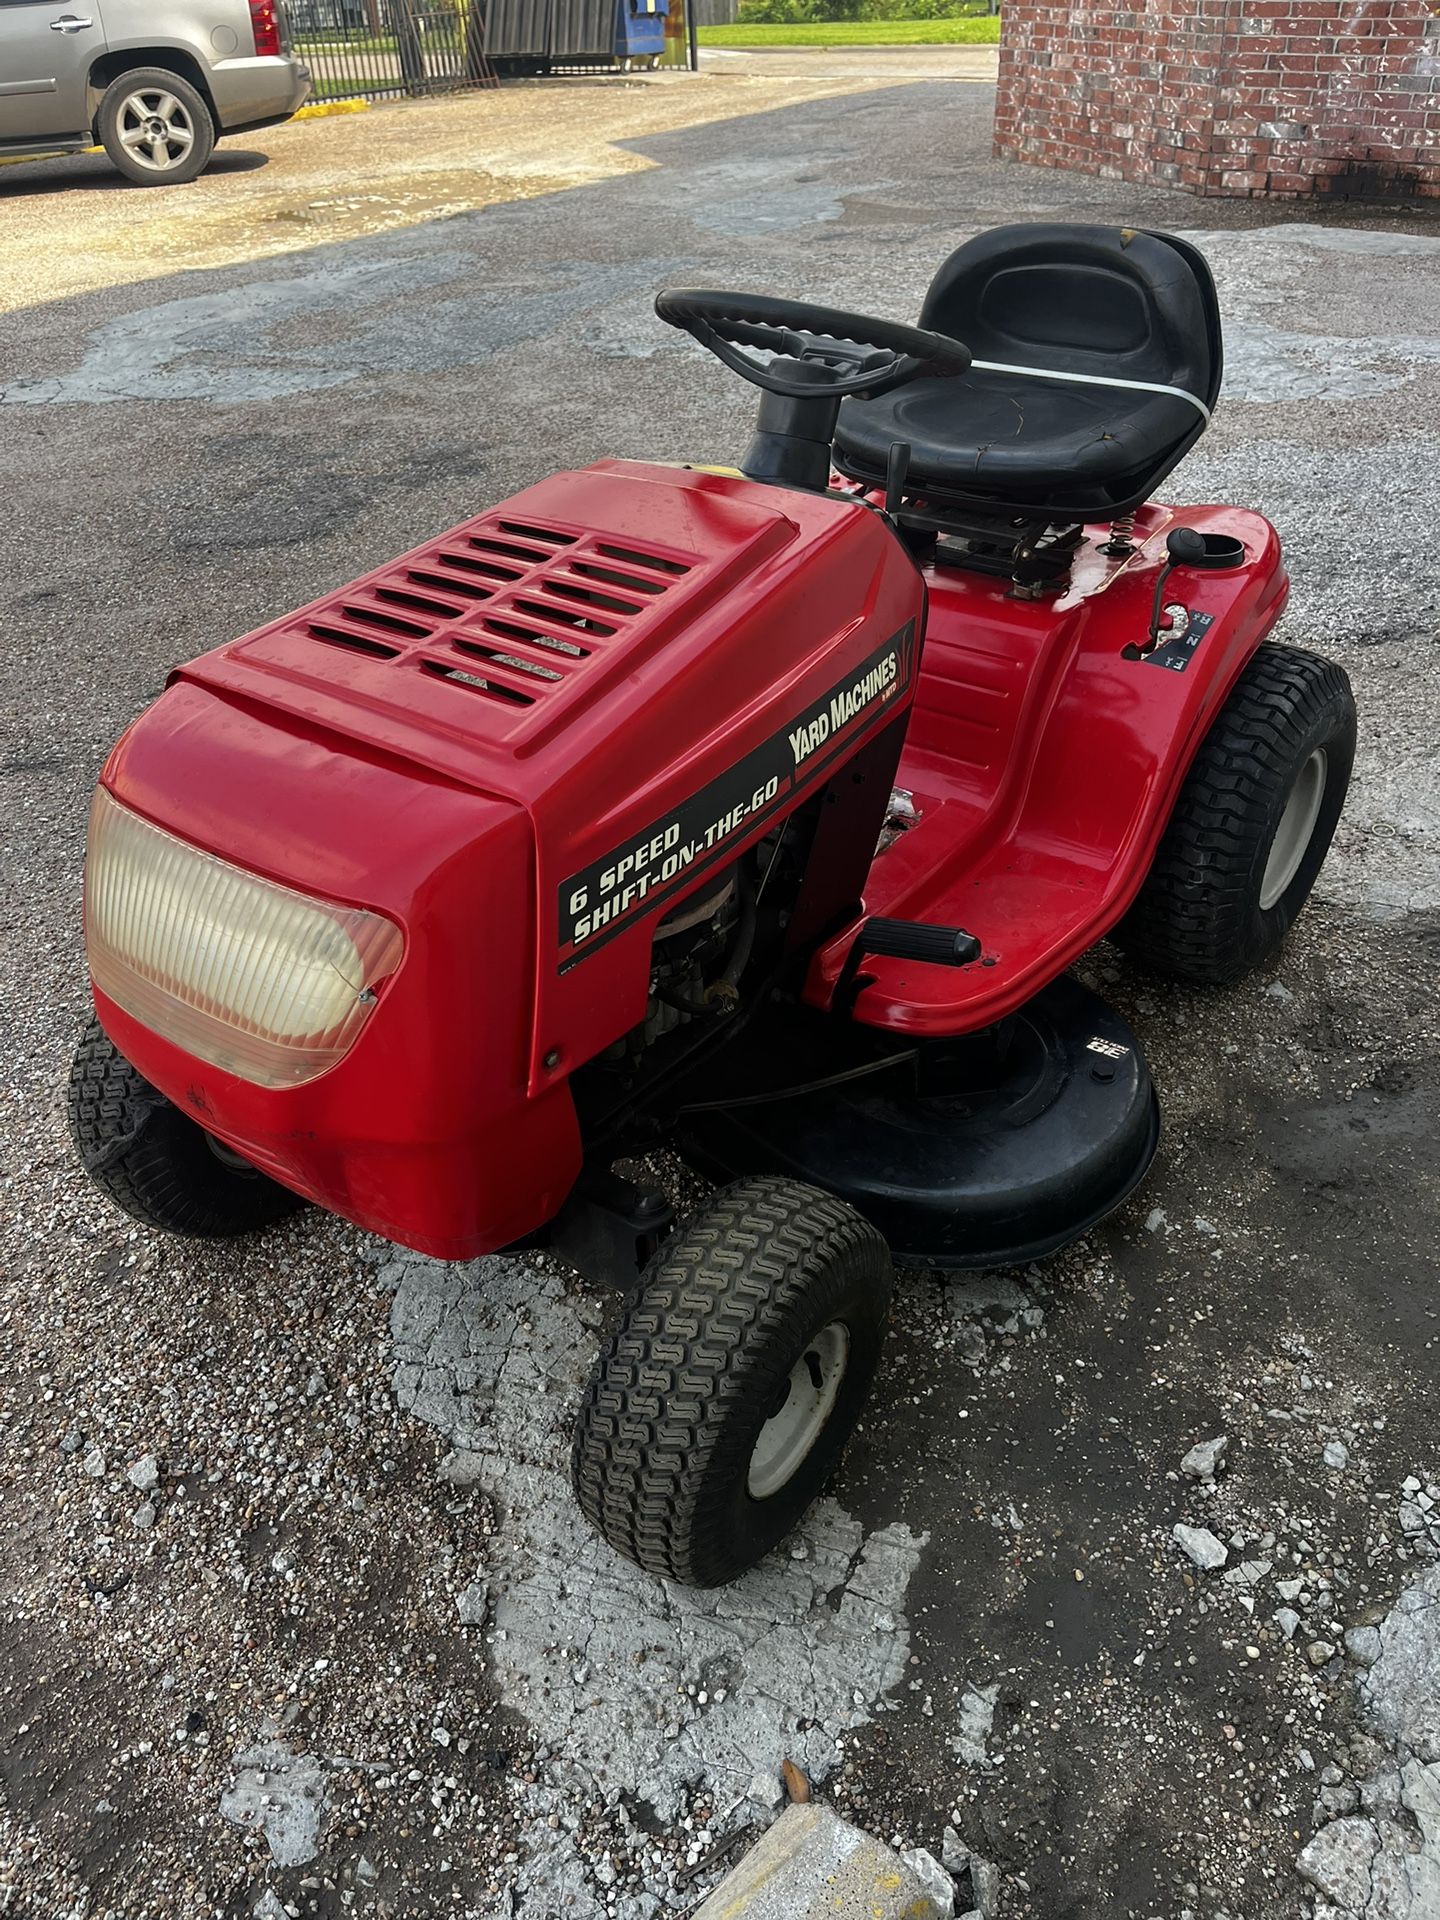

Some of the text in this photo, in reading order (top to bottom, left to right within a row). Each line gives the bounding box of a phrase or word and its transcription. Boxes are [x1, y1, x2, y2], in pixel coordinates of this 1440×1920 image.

[1186, 636, 1198, 646] N
[1200, 616, 1211, 625] R
[1173, 661, 1184, 670] F
[789, 651, 897, 764] YARD MACHINES
[570, 823, 680, 915] 6 SPEED
[574, 776, 778, 944] SHIFT-ON-THE-GO
